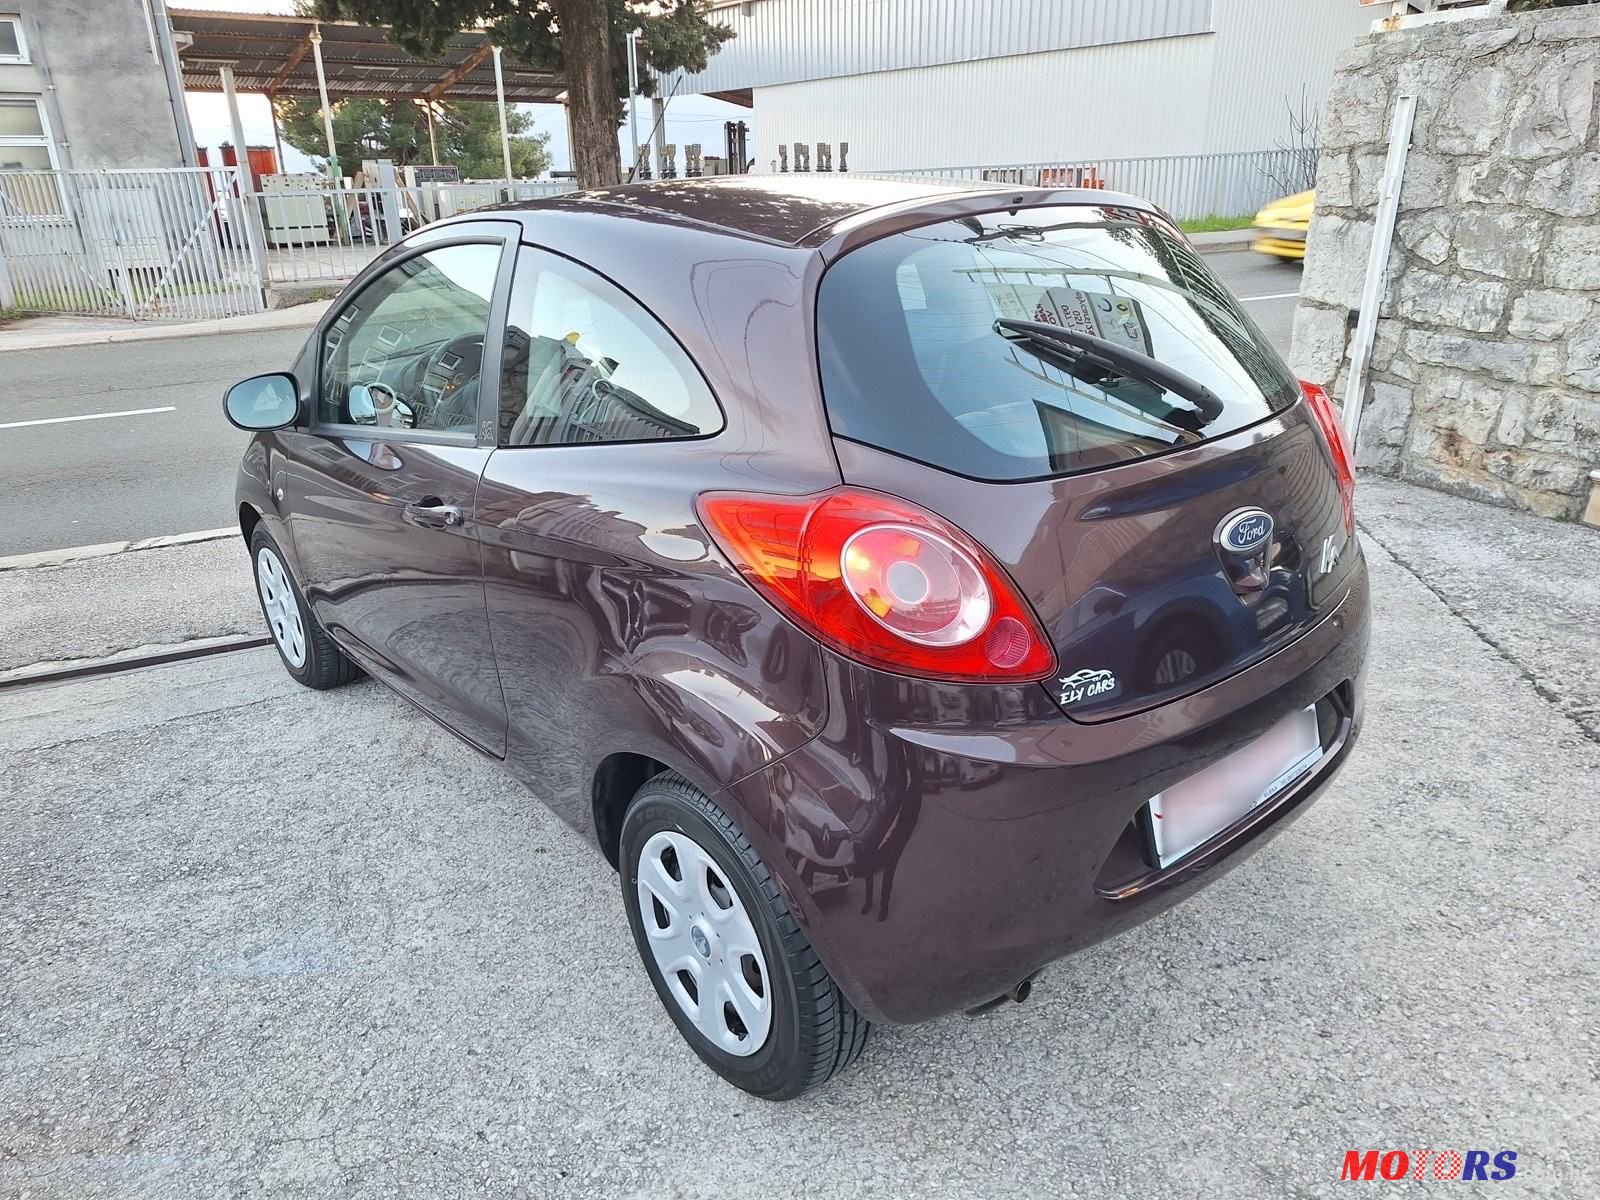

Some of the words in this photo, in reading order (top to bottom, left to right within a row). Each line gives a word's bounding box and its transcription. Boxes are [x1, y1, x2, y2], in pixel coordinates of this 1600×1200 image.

[1237, 518, 1266, 545] Ford
[1060, 687, 1085, 704] ELY
[1087, 677, 1115, 697] CARS
